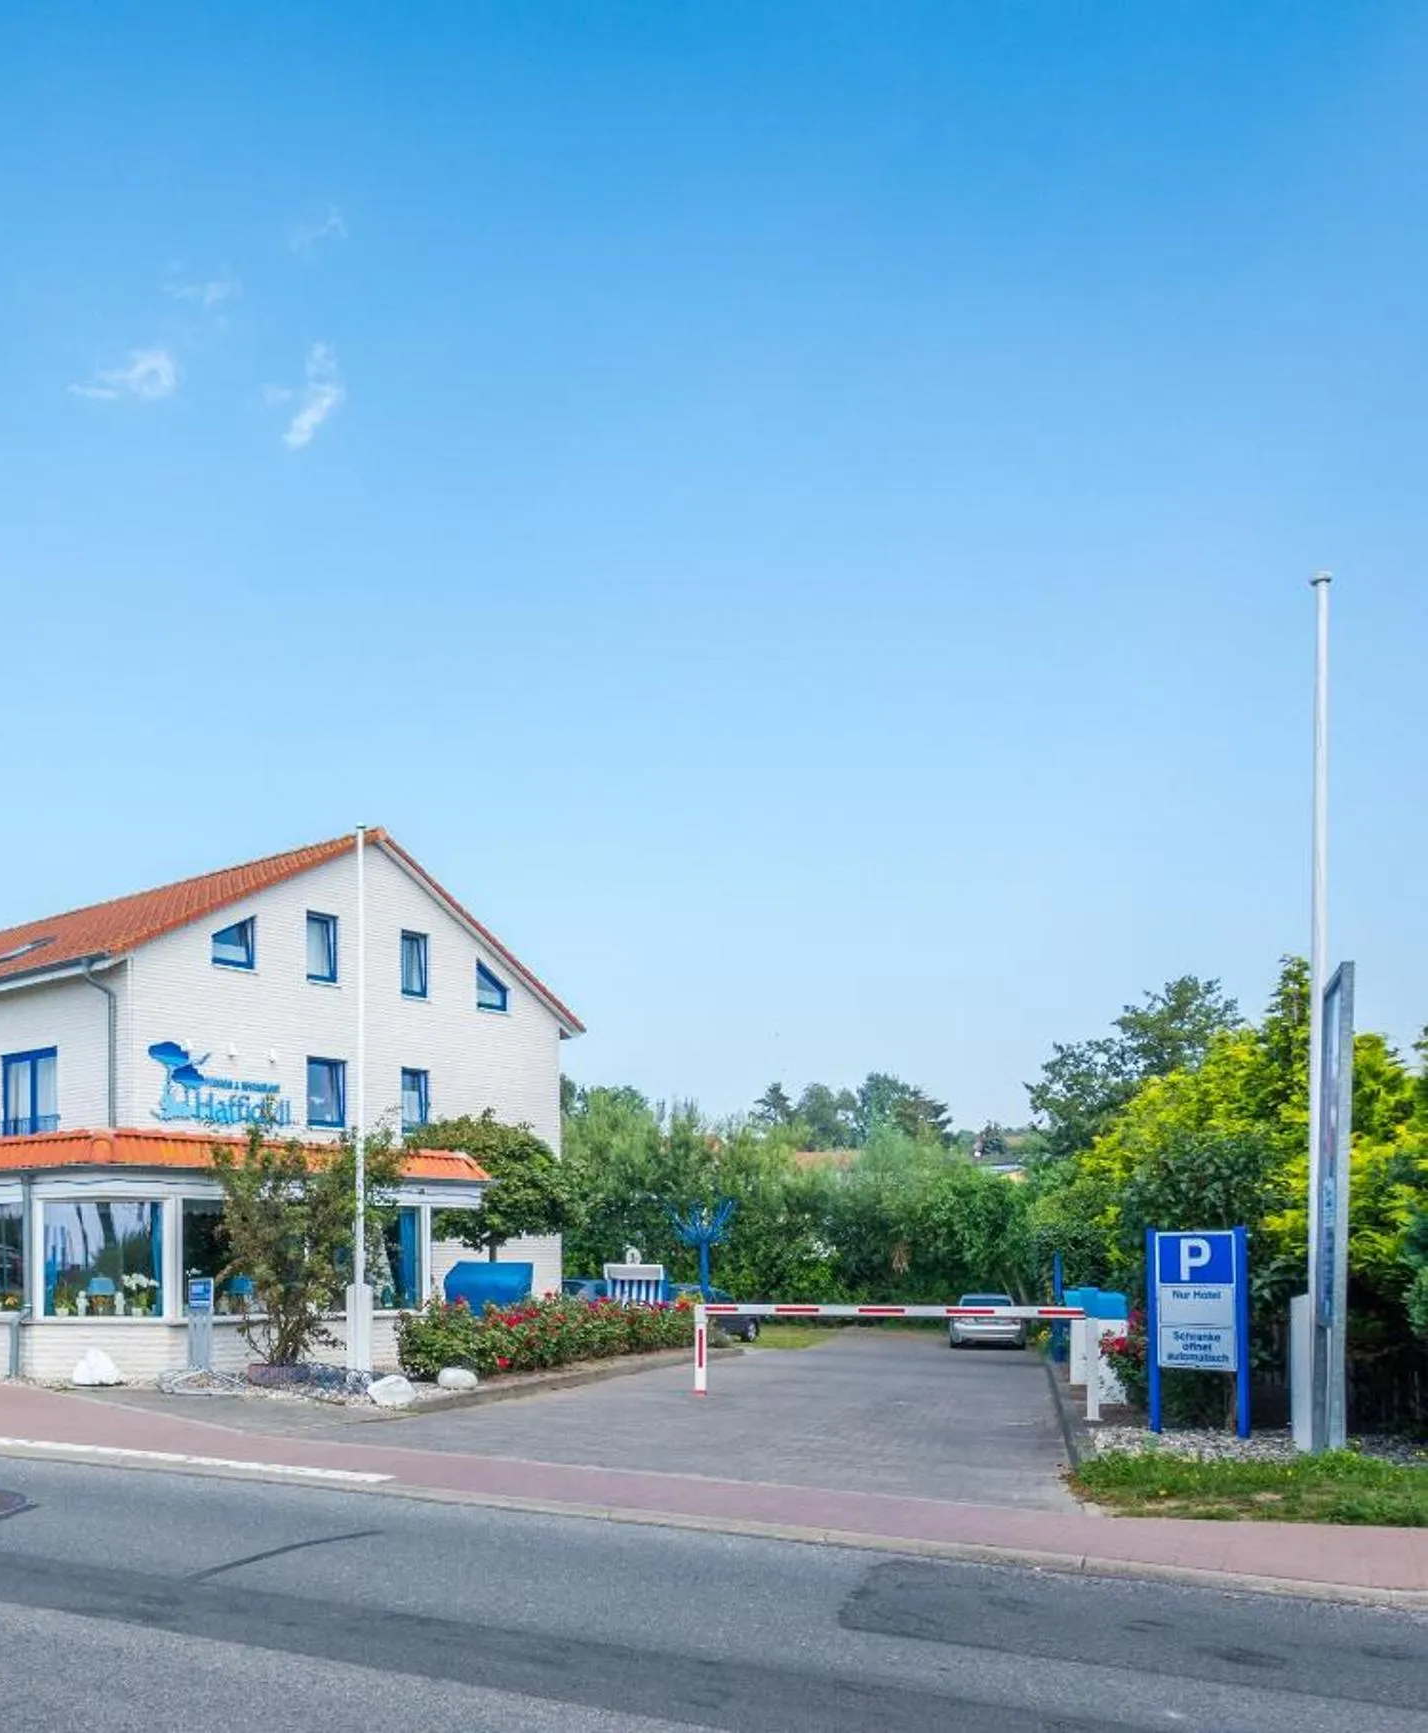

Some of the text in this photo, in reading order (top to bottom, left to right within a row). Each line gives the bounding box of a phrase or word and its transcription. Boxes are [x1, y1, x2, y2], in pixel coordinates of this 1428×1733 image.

[1179, 1238, 1211, 1281] P
[1172, 1290, 1221, 1300] Nur Hotel
[1173, 1331, 1221, 1342] Schranke
[1167, 1352, 1229, 1363] automatisch
